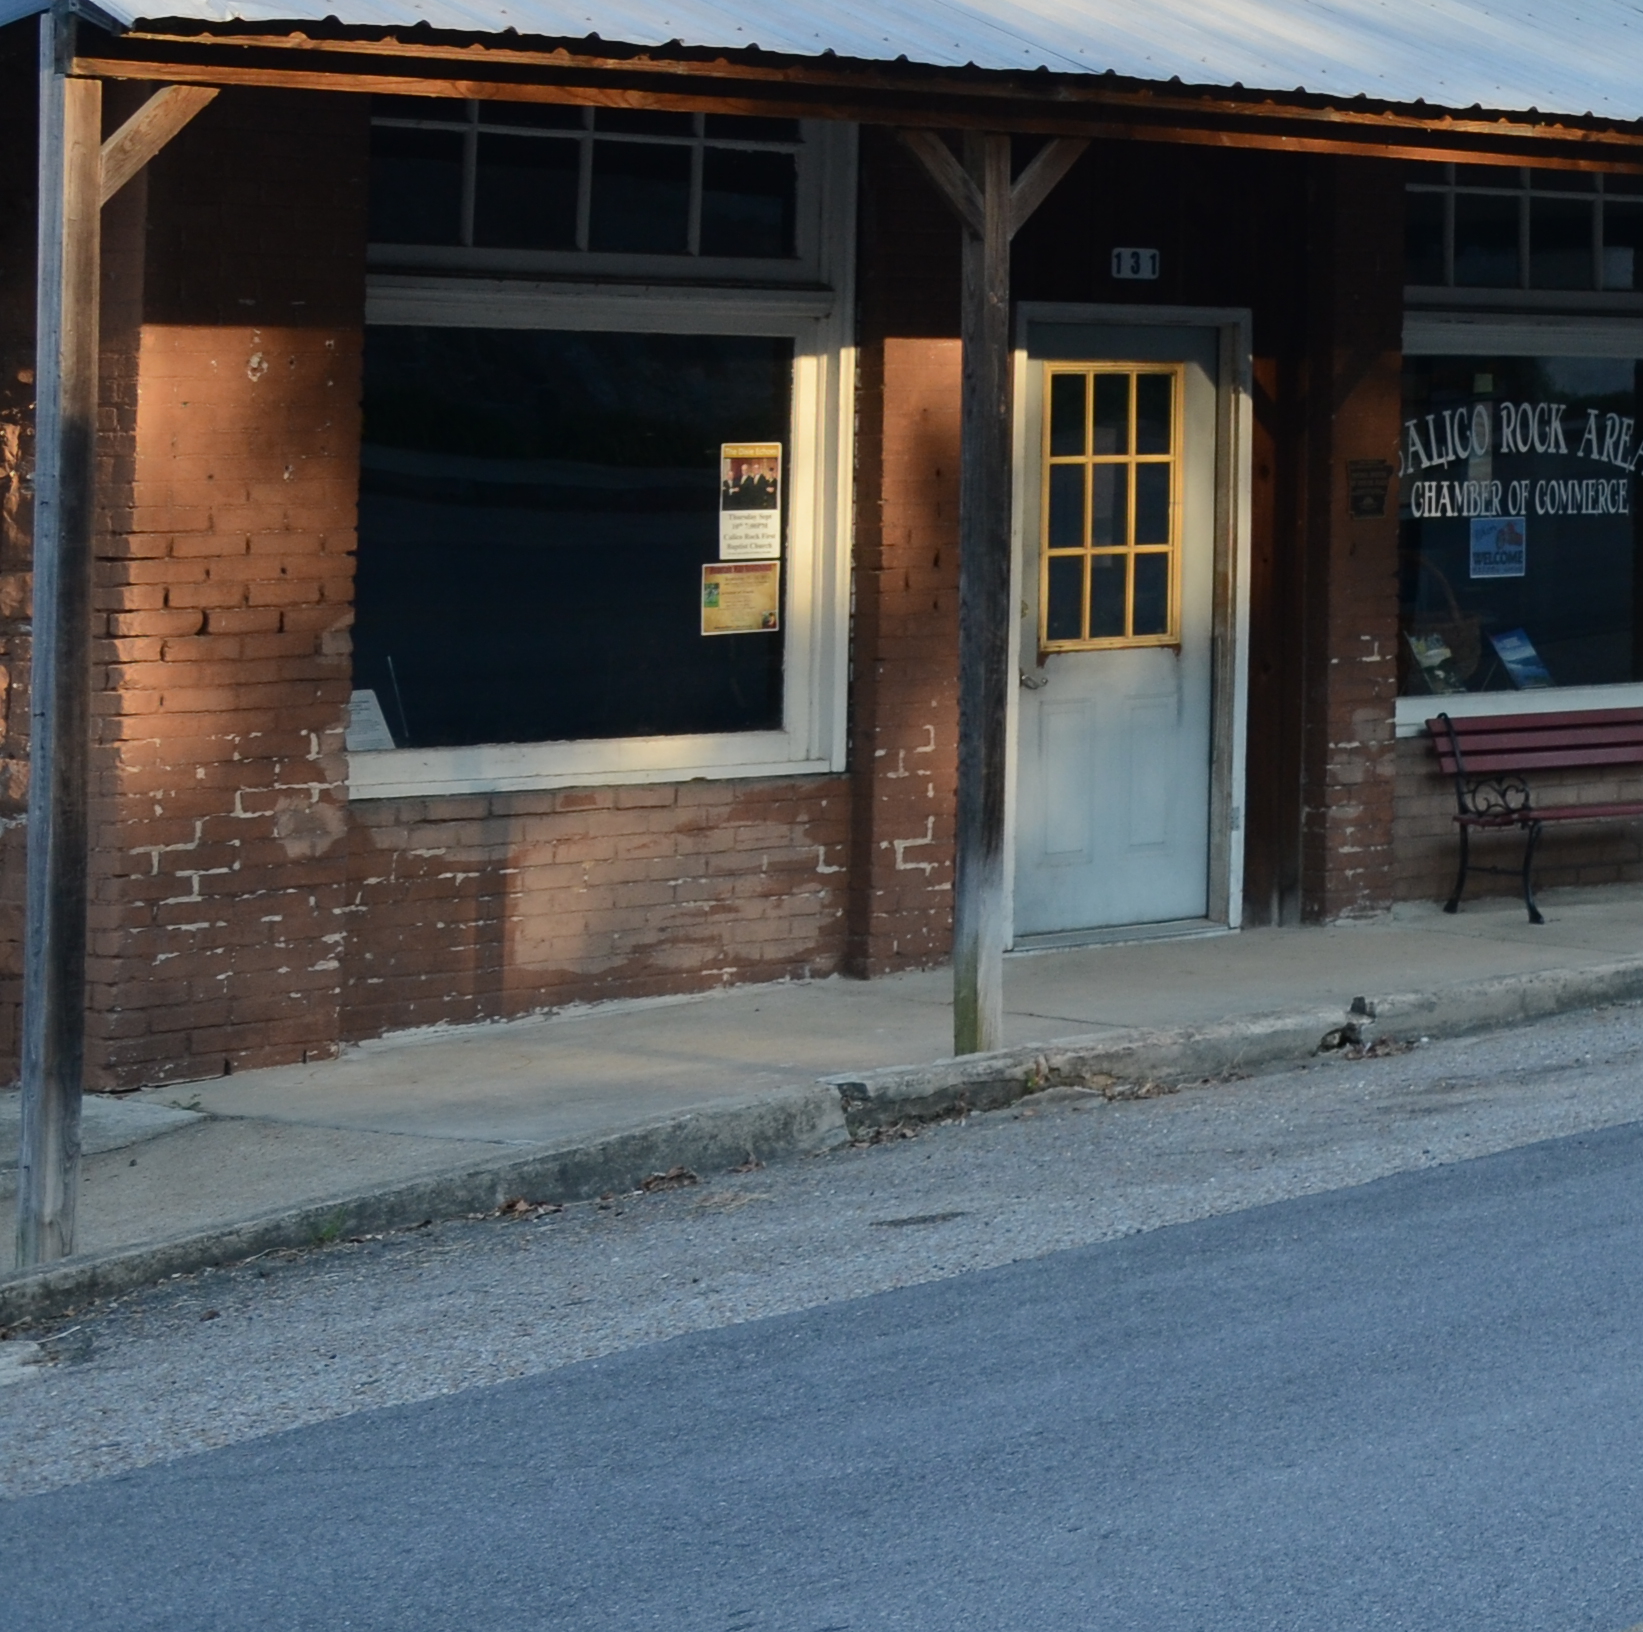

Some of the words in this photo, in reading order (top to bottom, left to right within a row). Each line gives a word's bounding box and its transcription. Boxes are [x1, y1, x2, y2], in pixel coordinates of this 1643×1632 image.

[1114, 251, 1157, 276] 131
[1500, 401, 1568, 454] ROCK
[1411, 480, 1502, 517] CHAMBER
[1508, 480, 1530, 515] OF
[1535, 479, 1629, 516] COMMERCE
[1473, 550, 1524, 565] WELCOME
